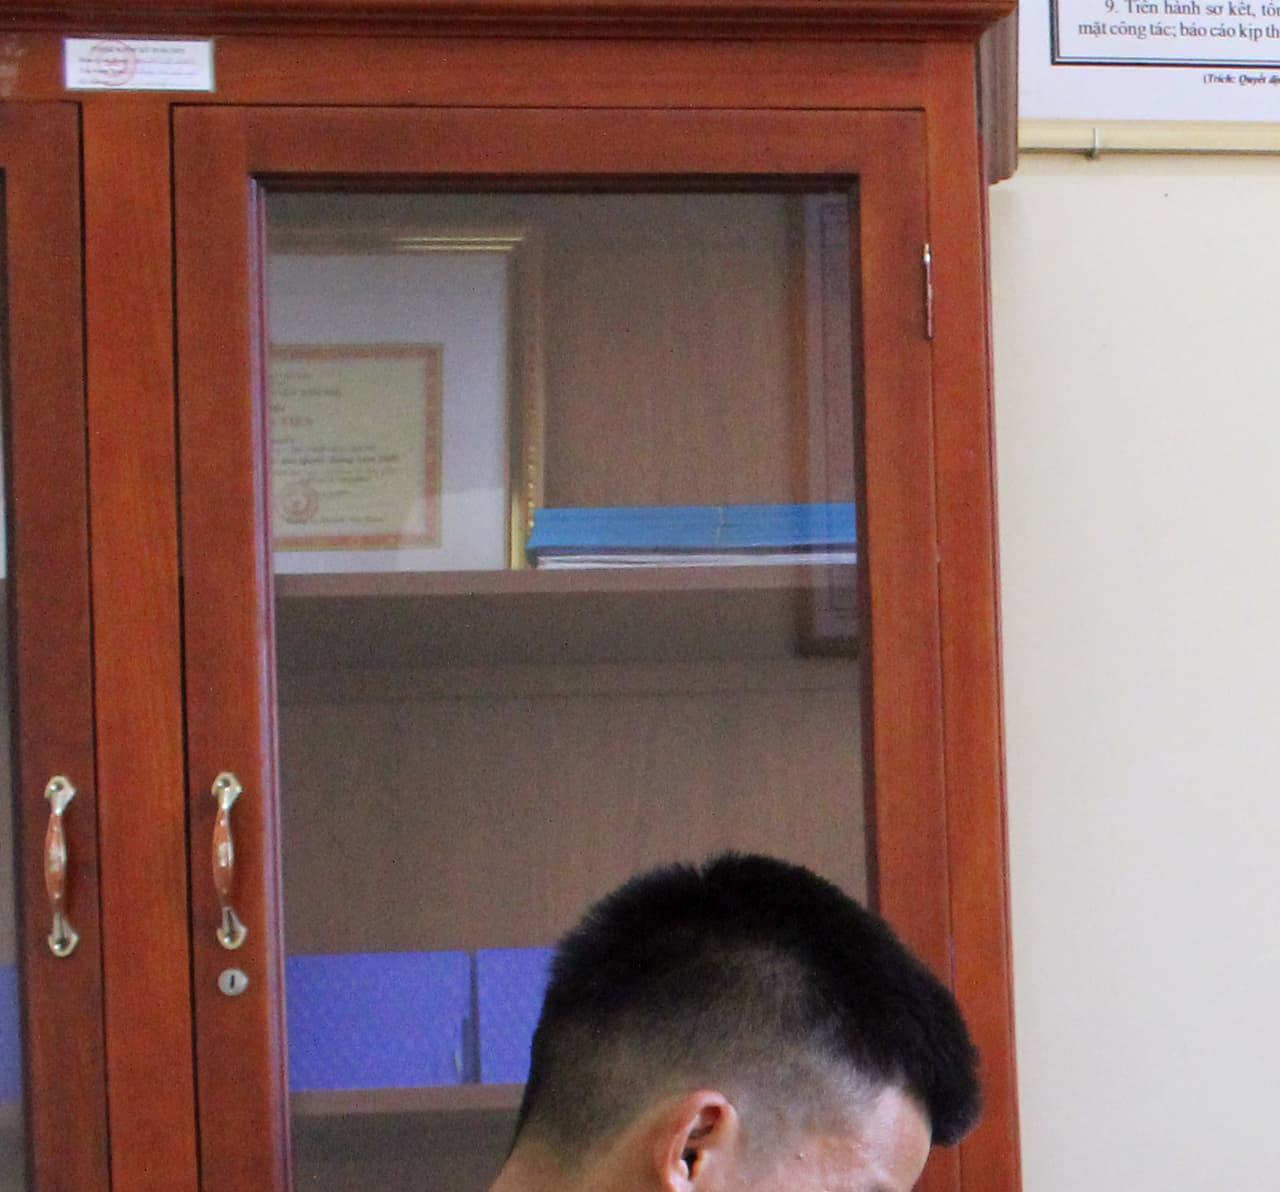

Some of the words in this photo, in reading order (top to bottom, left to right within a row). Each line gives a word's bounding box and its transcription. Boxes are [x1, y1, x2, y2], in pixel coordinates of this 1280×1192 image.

[1104, 0, 1119, 13] 9.
[1164, 0, 1200, 15] hành
[1206, 4, 1224, 15] sơ
[1079, 22, 1106, 38] mặt
[1109, 21, 1147, 39] công
[1150, 22, 1177, 37] tác;
[1180, 22, 1207, 37] báo
[1210, 23, 1236, 38] cáo
[1240, 23, 1263, 41] kịp
